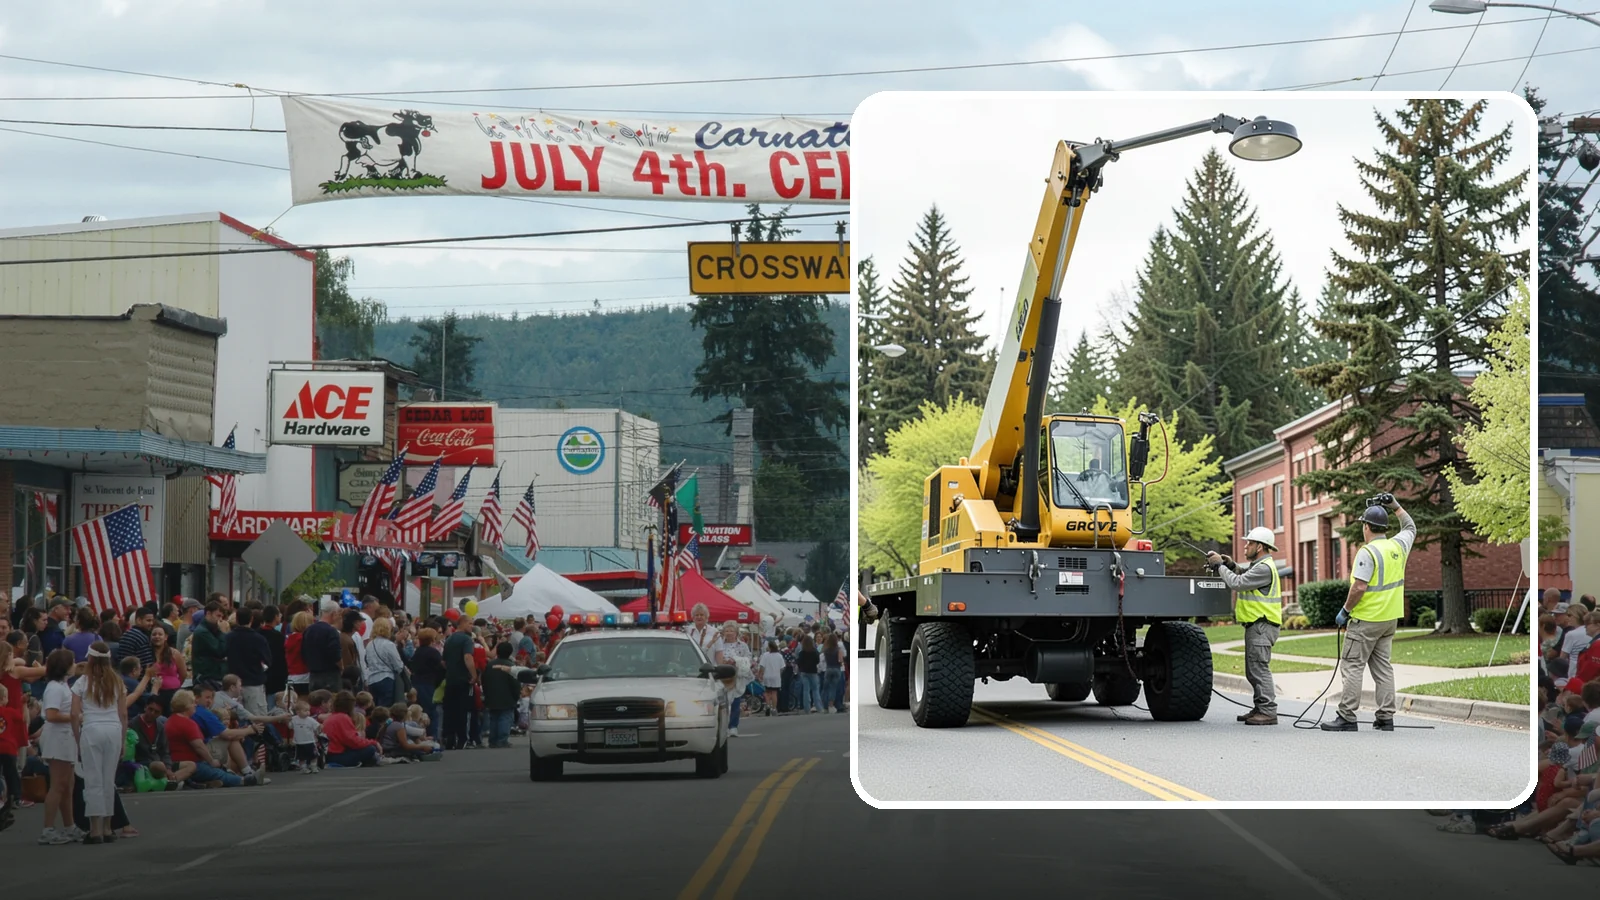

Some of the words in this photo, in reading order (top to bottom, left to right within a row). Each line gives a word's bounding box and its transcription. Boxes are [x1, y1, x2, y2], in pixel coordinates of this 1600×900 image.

[481, 141, 605, 192] JULY
[633, 150, 746, 198] 4th.
[697, 254, 850, 280] CROSSWA
[283, 380, 373, 420] ACE
[406, 409, 452, 421] CEDAR
[461, 409, 485, 421] LOG
[283, 421, 371, 436] Hardware
[416, 428, 477, 447] Coca-Cola
[95, 485, 124, 495] Vincent
[126, 486, 136, 495] de
[137, 486, 155, 495] Paul
[688, 526, 741, 535] CRNATION
[1066, 520, 1118, 533] GROVE
[699, 535, 730, 543] GLASS
